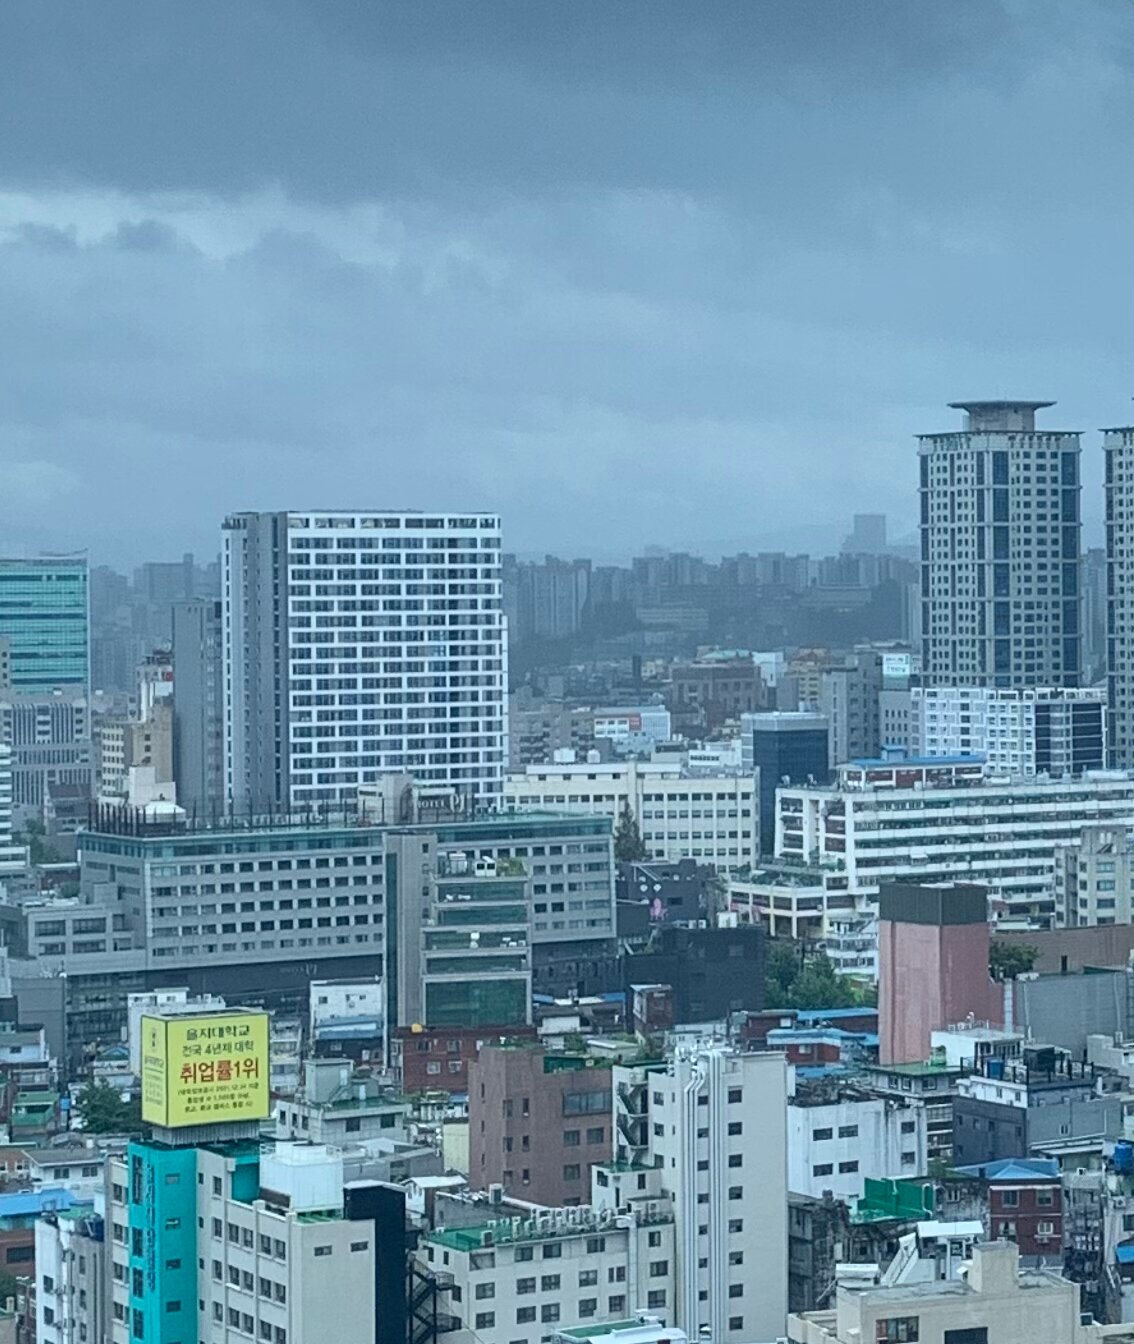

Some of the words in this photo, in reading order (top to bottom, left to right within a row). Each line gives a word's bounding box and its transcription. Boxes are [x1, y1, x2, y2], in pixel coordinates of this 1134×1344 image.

[186, 1025, 250, 1041] 을지대학교
[182, 1044, 202, 1057] 전국
[204, 1041, 232, 1055] 4년제
[234, 1040, 254, 1053] 대학
